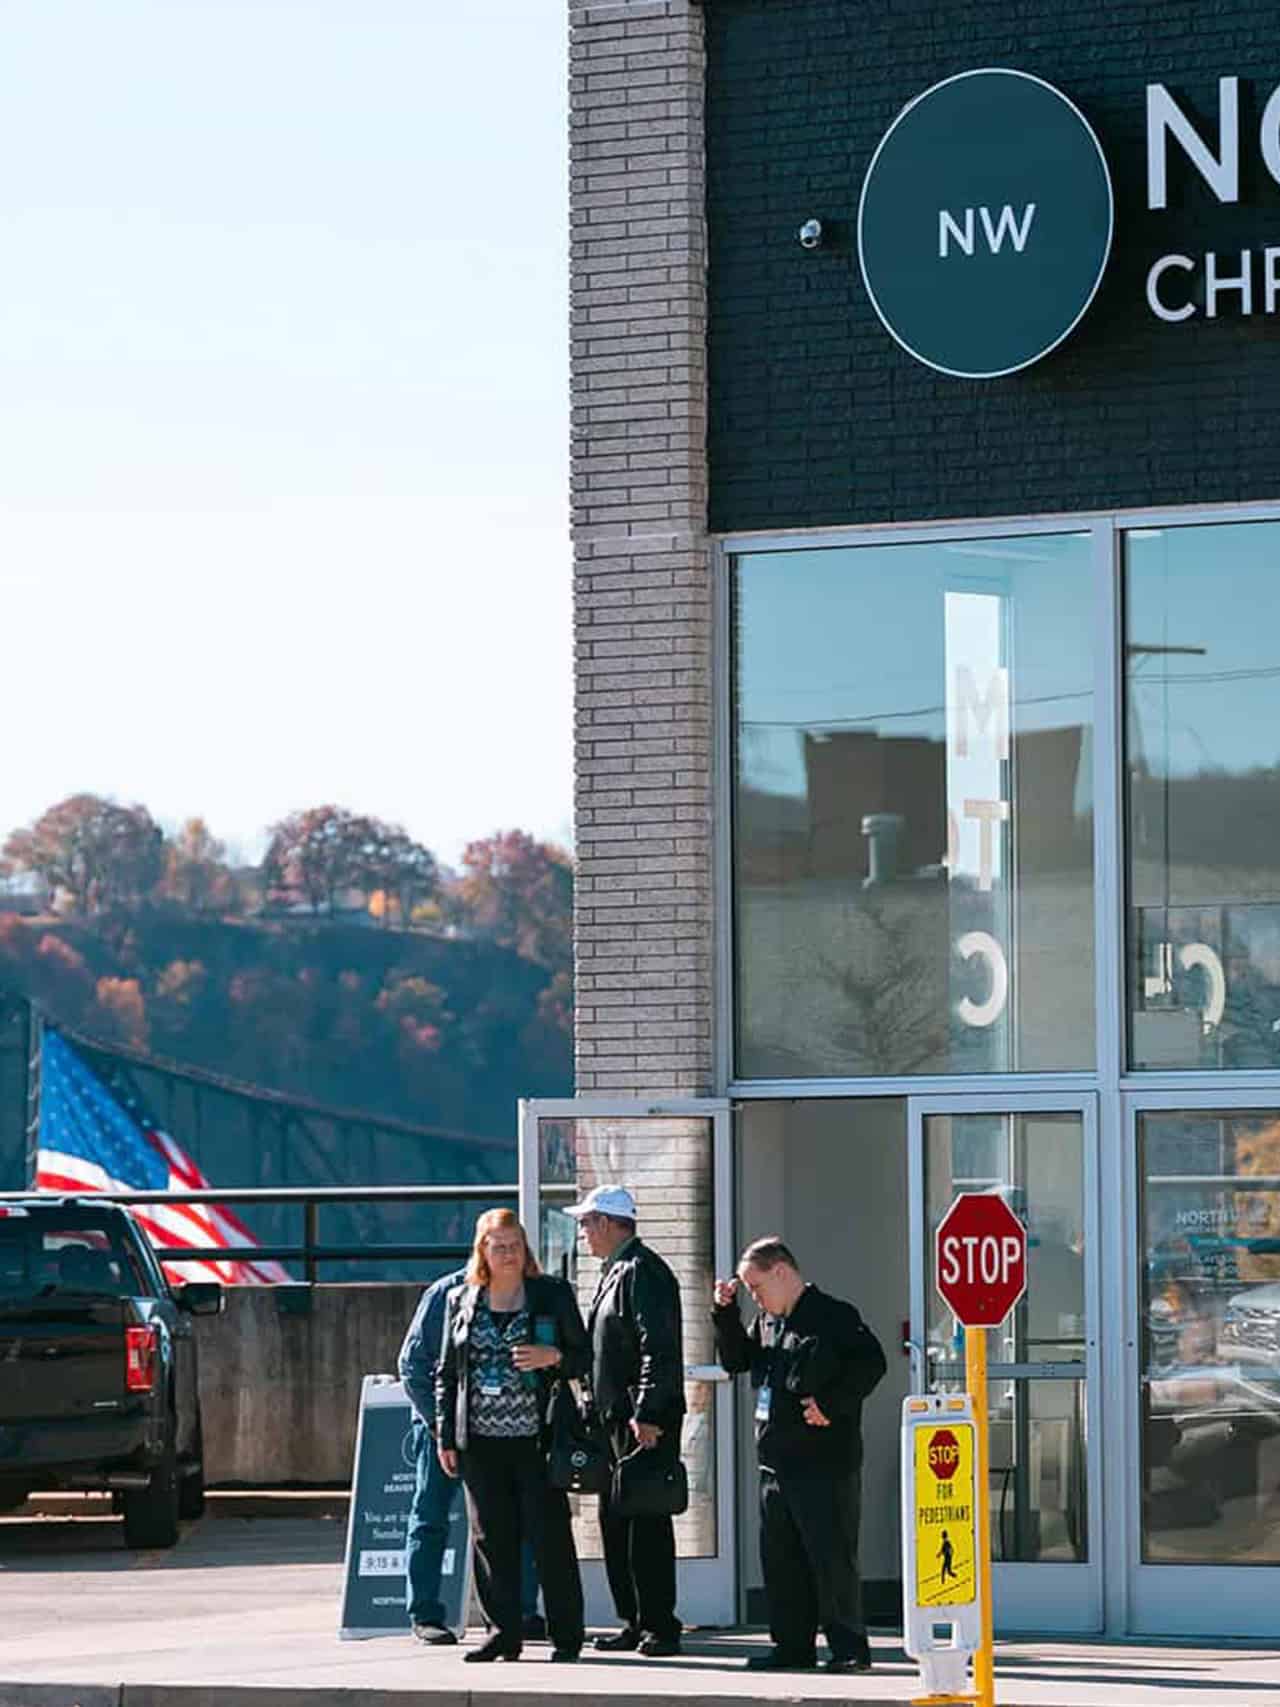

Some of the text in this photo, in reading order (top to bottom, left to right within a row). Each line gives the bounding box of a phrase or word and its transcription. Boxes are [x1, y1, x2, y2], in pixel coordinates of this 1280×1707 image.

[937, 203, 1036, 258] NW
[941, 1236, 1022, 1285] STOP
[929, 1445, 959, 1465] STOP
[936, 1482, 954, 1500] FOR
[918, 1505, 970, 1527] PEDESTRIANS
